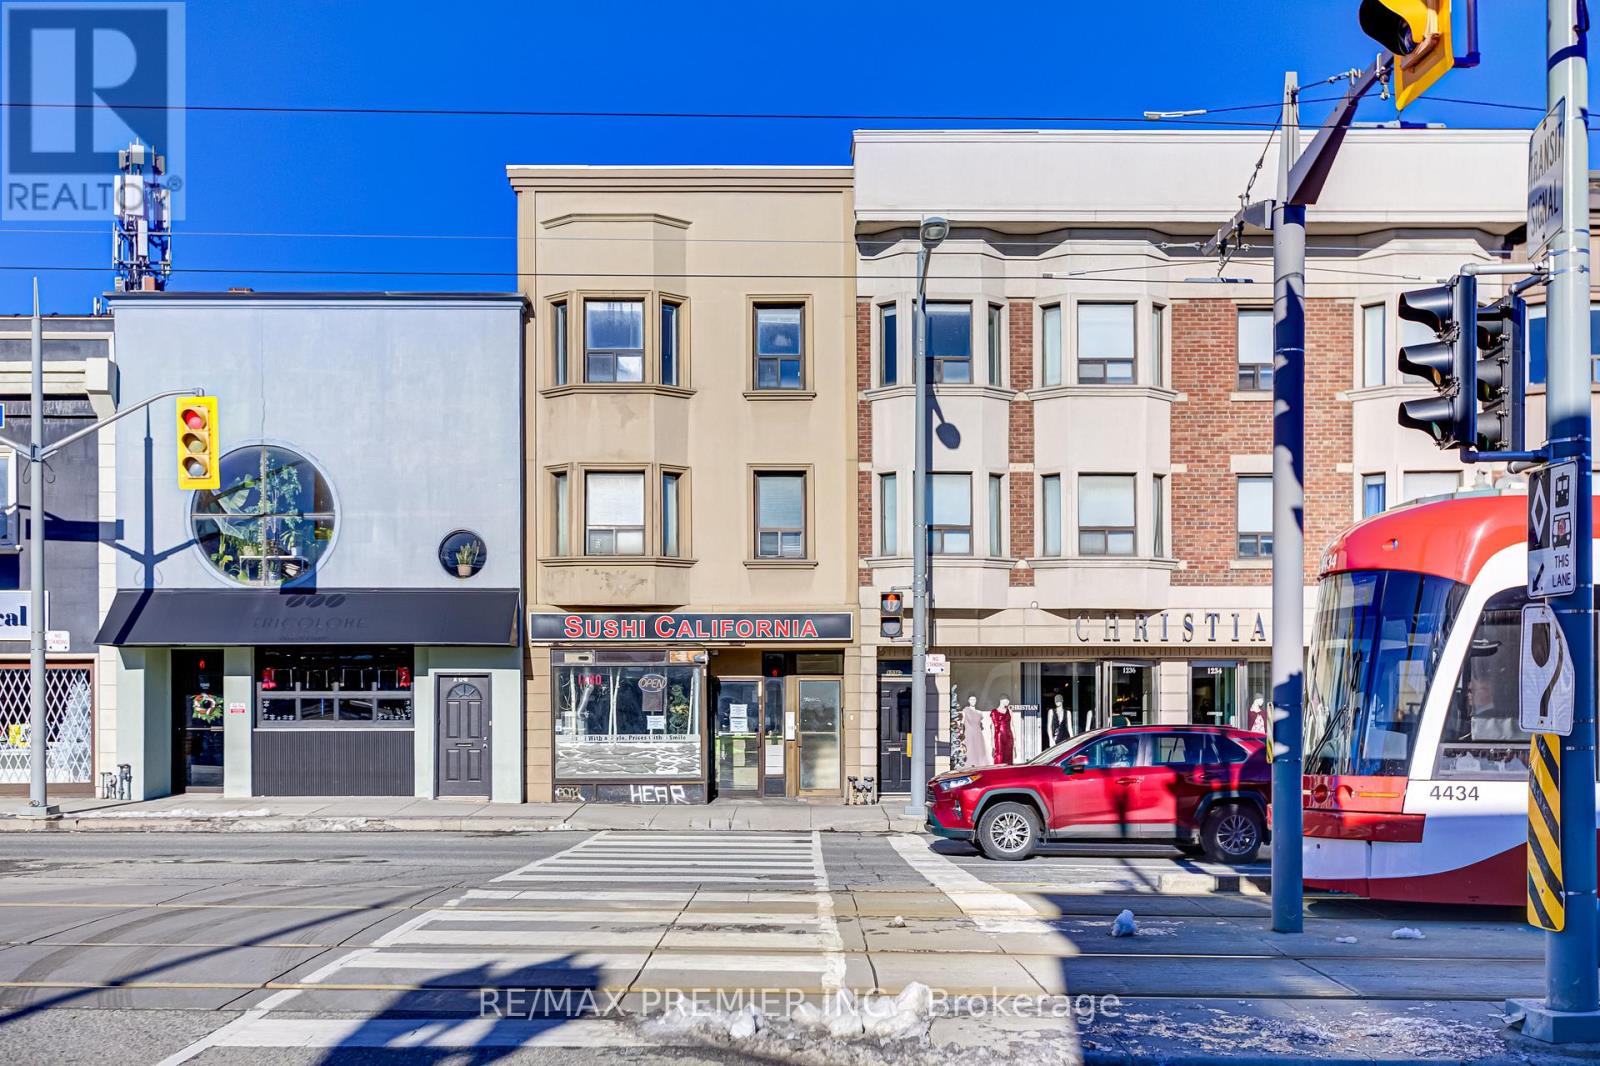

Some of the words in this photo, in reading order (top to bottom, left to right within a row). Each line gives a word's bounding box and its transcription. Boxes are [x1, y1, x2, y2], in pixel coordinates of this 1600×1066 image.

[1529, 121, 1562, 185] TRANSIT
[1531, 178, 1559, 236] SIGNAL
[1554, 554, 1570, 568] THIS
[1552, 572, 1572, 588] LANE
[563, 615, 646, 638] SUSHI
[655, 615, 819, 638] CALIFORNIA
[1076, 612, 1266, 641] CHRISTIA
[639, 677, 665, 689] OPEN
[630, 785, 691, 805] HEAR
[1429, 785, 1480, 801] 4434
